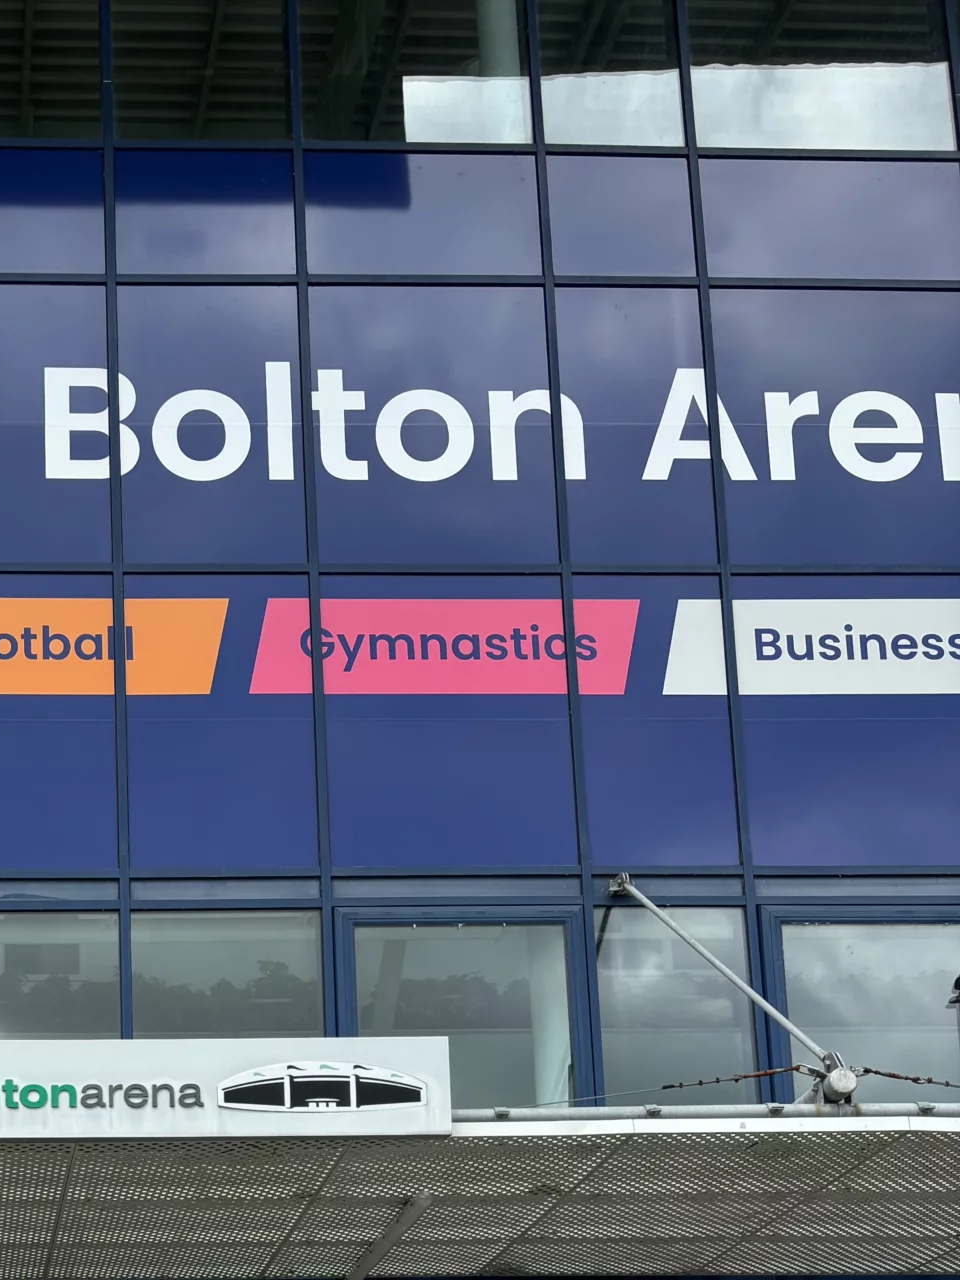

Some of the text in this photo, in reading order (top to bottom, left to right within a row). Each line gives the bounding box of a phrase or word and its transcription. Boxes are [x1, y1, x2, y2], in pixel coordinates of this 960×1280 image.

[43, 361, 586, 482] Bolton
[299, 623, 598, 673] Gymnastics
[753, 623, 960, 661] Business
